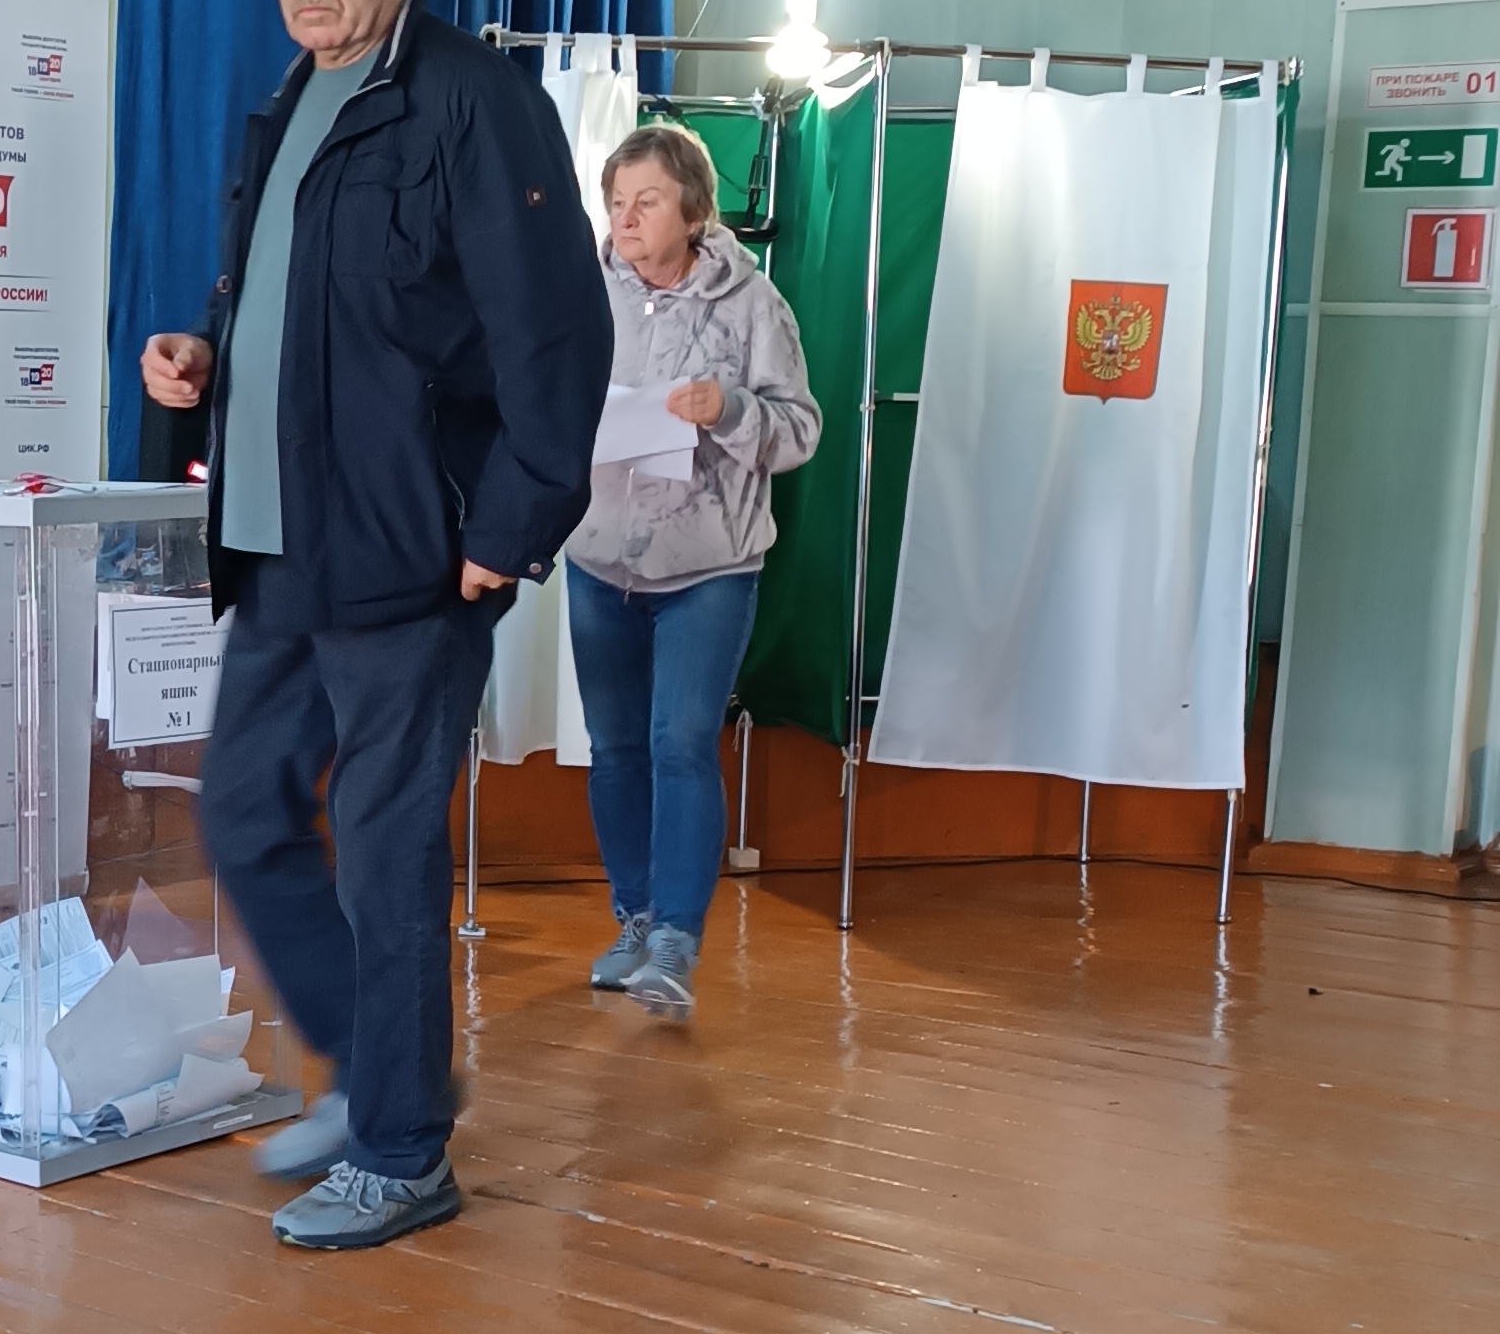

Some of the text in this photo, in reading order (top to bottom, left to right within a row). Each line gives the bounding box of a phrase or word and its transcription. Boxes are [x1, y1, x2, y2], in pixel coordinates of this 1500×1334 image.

[28, 66, 37, 76] 18
[50, 58, 60, 69] 20
[1376, 72, 1459, 85] ПРИ ПОЖАРЕ
[1466, 71, 1496, 94] 01
[1386, 87, 1446, 99] ЗВОНИТЬ
[20, 377, 29, 386] 18
[41, 367, 51, 378] 20
[18, 444, 49, 454] ЦИК.РФ
[161, 685, 198, 700] ящик
[166, 711, 182, 728] №
